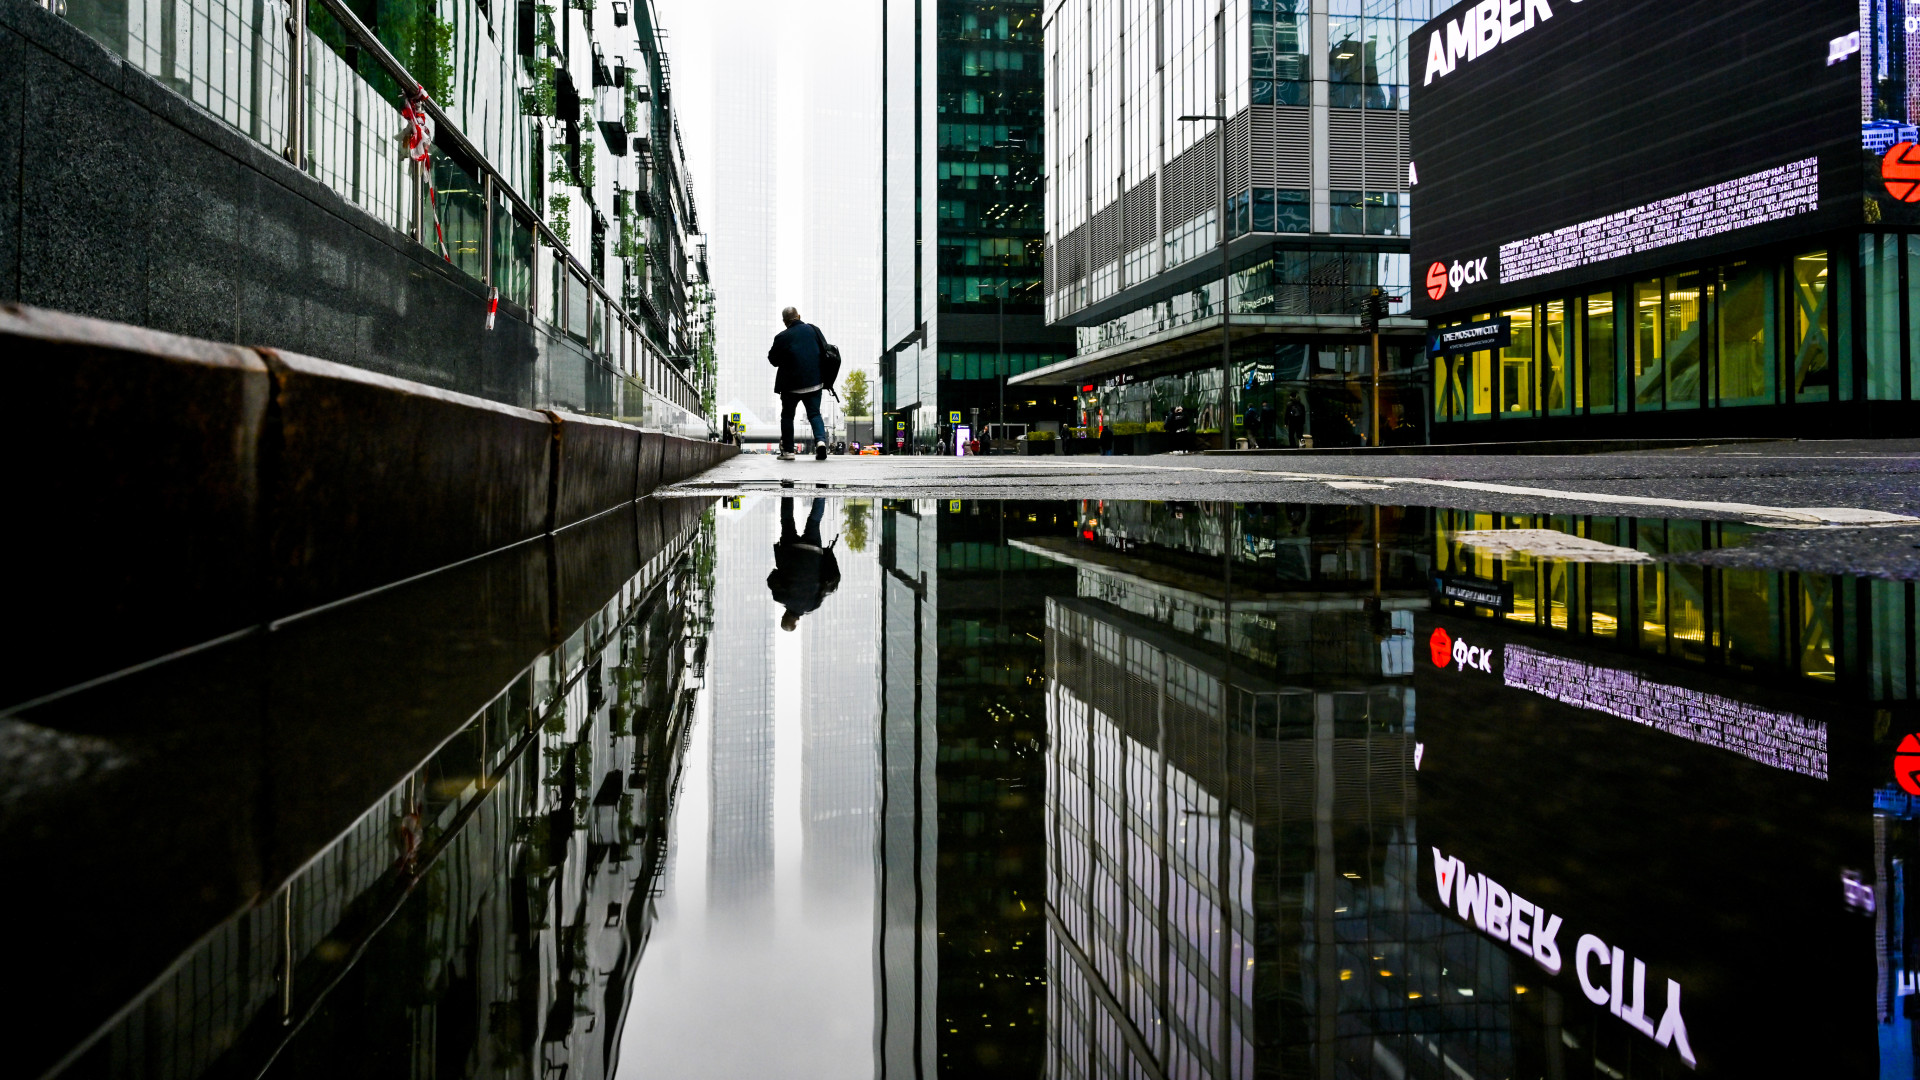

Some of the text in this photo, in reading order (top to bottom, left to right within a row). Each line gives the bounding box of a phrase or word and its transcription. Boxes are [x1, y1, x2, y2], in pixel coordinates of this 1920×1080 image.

[1786, 157, 1817, 173] РЕЗУЛЬТАТЫ
[1801, 167, 1811, 178] ЦЕН
[1807, 184, 1817, 195] ЦЕН
[1449, 257, 1488, 292] ФСК
